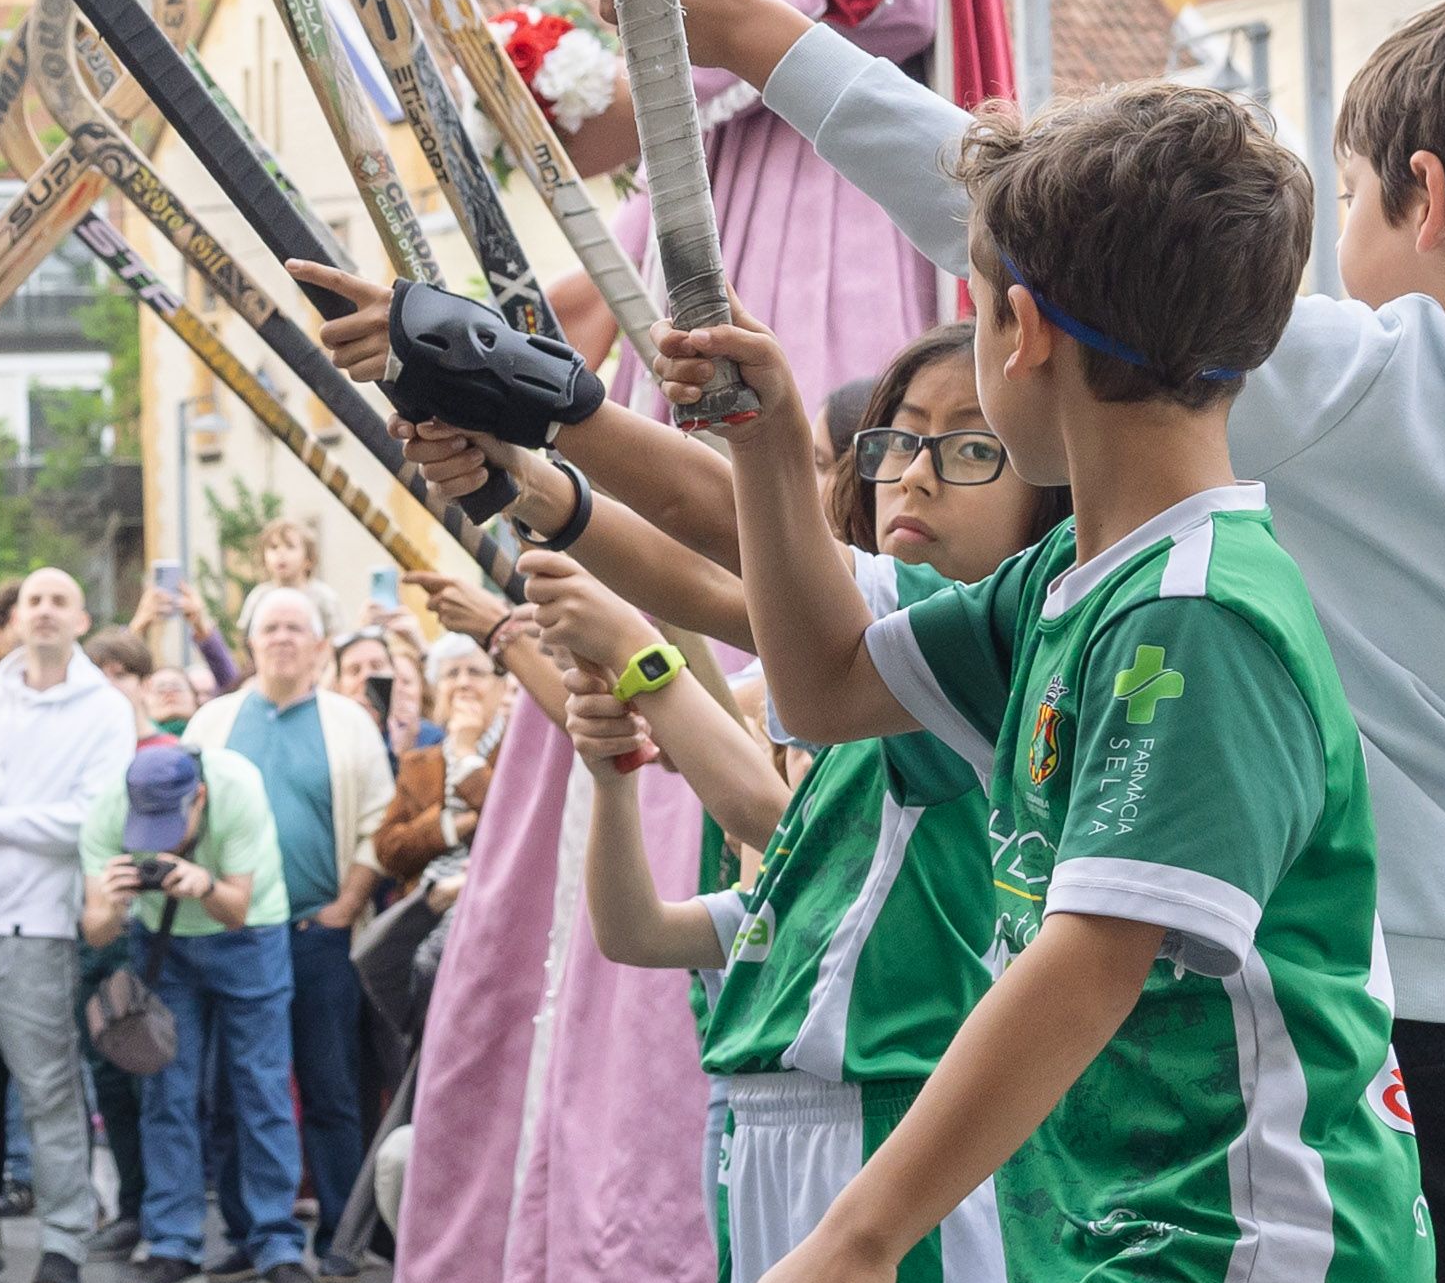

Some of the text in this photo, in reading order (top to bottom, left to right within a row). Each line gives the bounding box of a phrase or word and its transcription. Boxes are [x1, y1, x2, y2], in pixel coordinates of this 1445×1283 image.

[374, 193, 401, 239] CLUB
[1087, 736, 1131, 837] SELVA
[1113, 737, 1155, 837] FARMÀCIA
